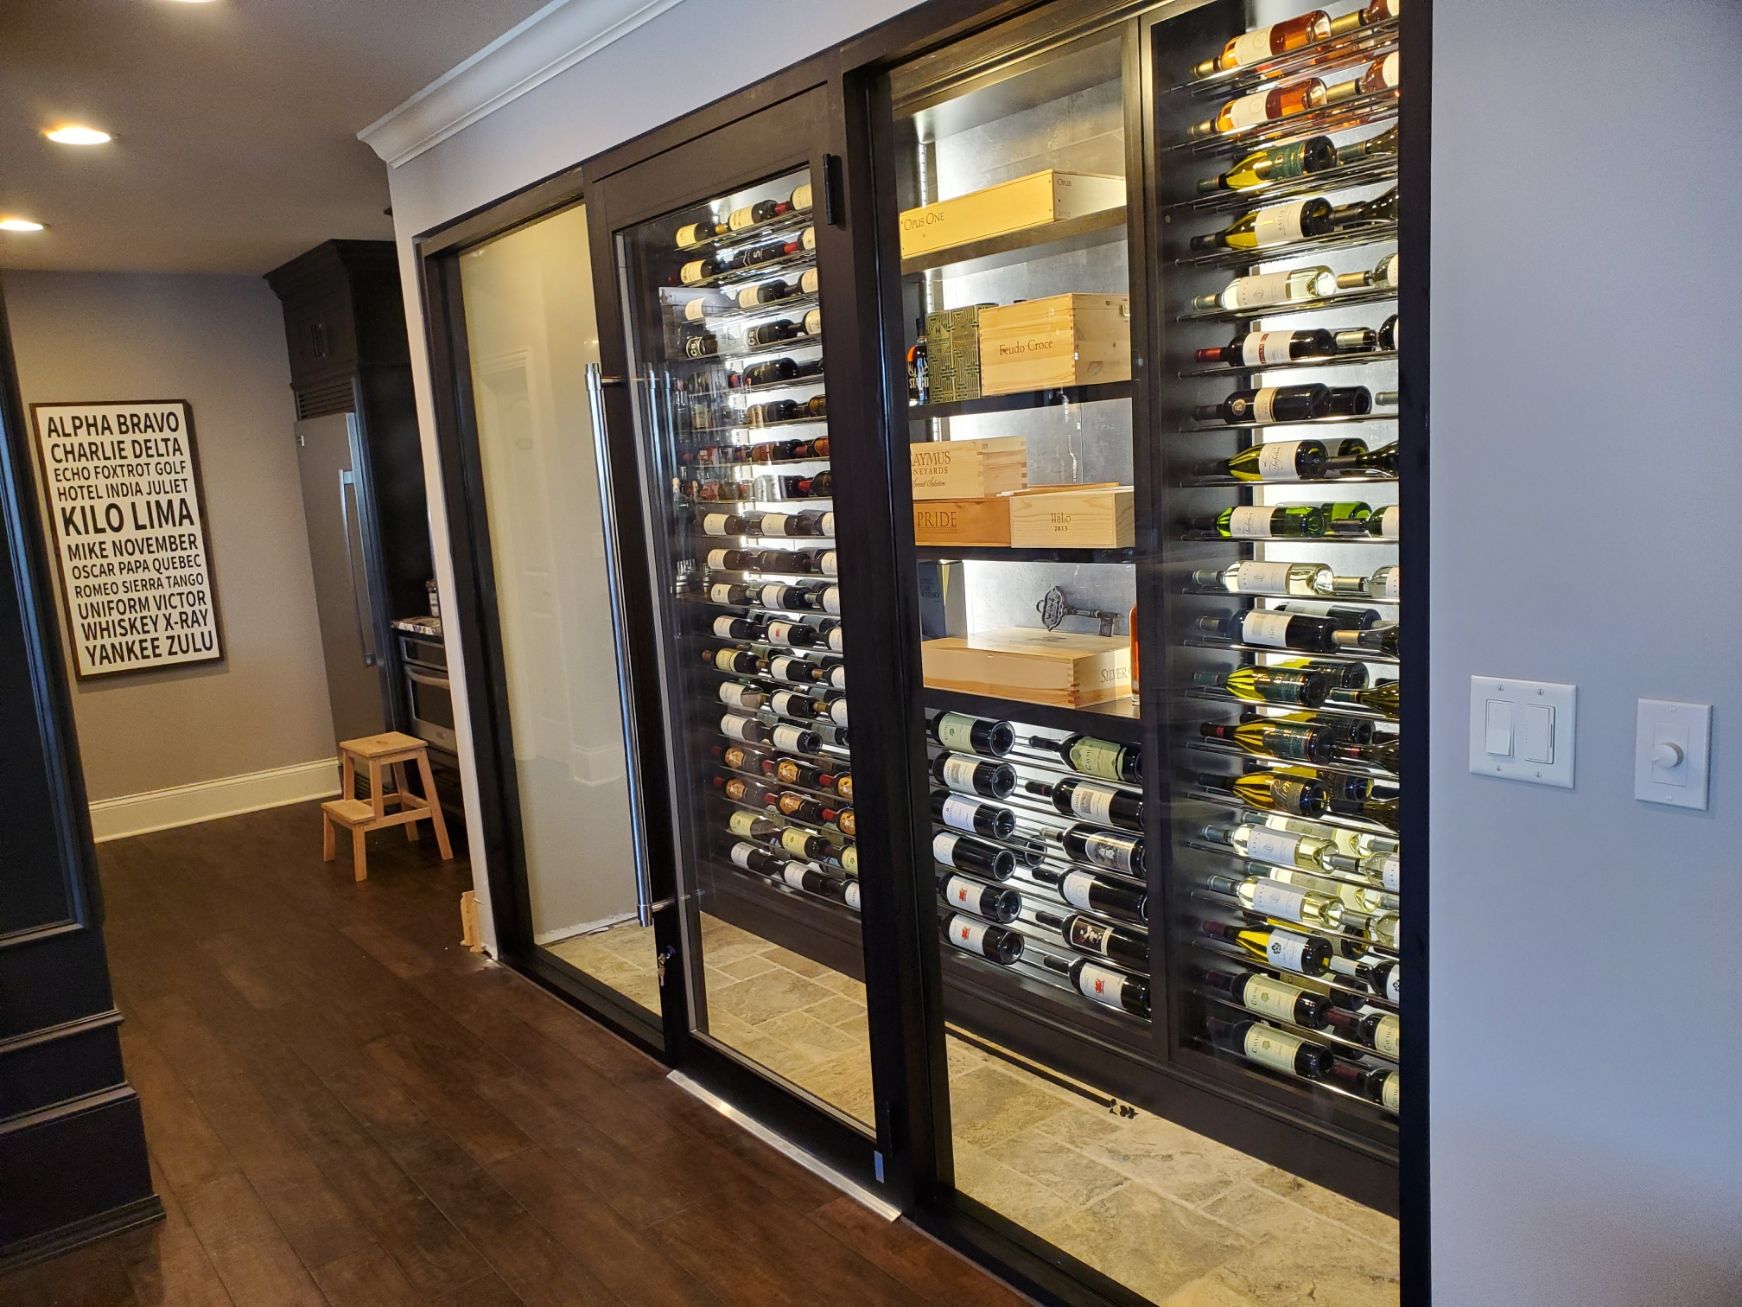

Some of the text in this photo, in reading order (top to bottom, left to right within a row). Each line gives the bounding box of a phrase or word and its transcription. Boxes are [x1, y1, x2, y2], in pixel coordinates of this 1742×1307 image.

[999, 339, 1053, 356] Feudo Croce
[47, 411, 180, 438] ALPHA BRAVO
[50, 437, 183, 463] CHARLIE DELTA
[912, 451, 951, 466] AYMUS
[54, 460, 187, 482] ECHO FOXTROT GOLF
[913, 466, 949, 475] NEYARDS
[57, 478, 189, 502] HOTEL INDIA JULIET
[61, 498, 195, 537] KILO LIMA
[917, 511, 958, 528] PRIDE
[67, 533, 198, 562] MIKE NOVEMBER
[72, 554, 202, 580] OSCAR PAPA QUEBEC
[75, 573, 204, 598] ROMEO SIERRA TANGO
[78, 590, 206, 620] UNIFORM VICTOR
[81, 609, 209, 642] WHISKEY X-RAY
[85, 630, 214, 667] YANKEE ZULU
[1101, 667, 1127, 683] SILVER
